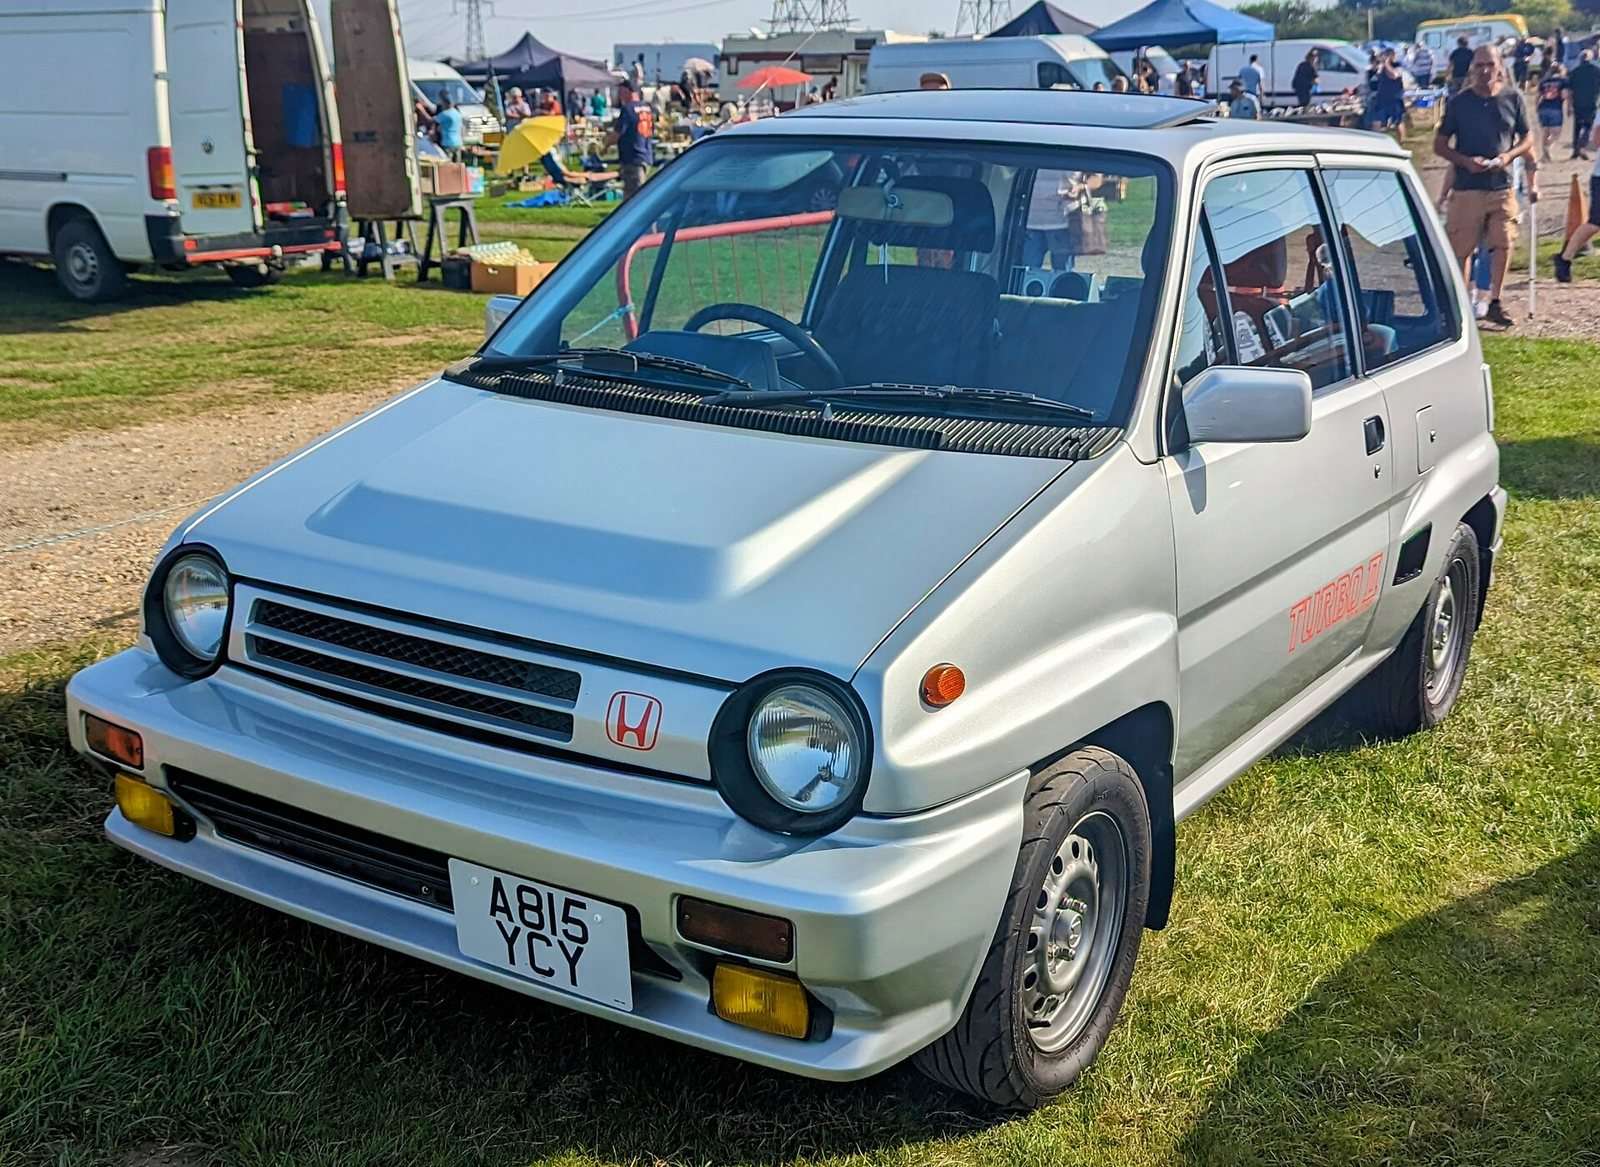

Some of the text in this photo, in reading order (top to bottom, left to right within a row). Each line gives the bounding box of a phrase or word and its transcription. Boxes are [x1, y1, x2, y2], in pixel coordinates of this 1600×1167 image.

[1288, 564, 1364, 655] TURBO
[489, 876, 589, 946] A815
[495, 919, 584, 987] YCY
